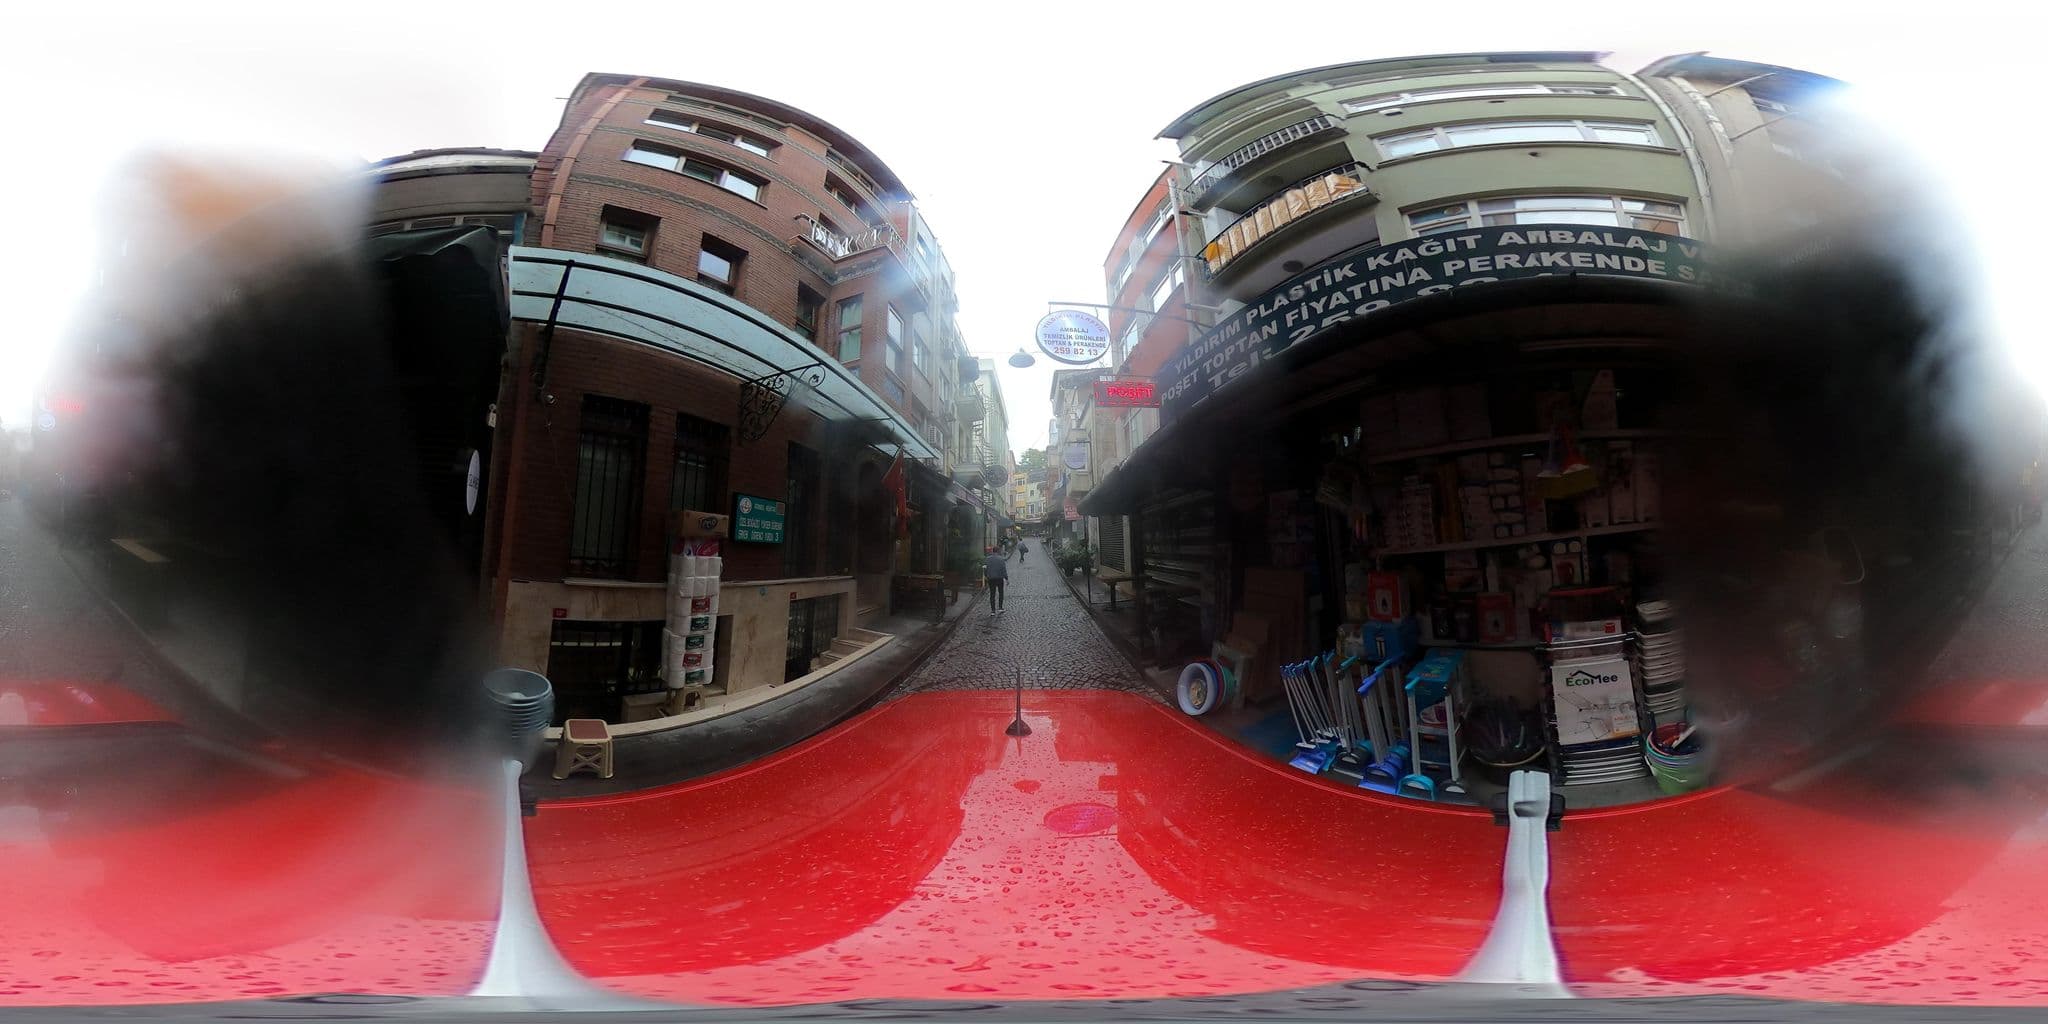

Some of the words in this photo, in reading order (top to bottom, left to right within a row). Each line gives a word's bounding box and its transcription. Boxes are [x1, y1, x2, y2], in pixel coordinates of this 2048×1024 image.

[1161, 368, 1200, 407] POŞET
[1203, 319, 1278, 373] TOPTAN
[1285, 266, 1433, 328] FİYATINA
[1174, 319, 1241, 374] YILDIRIM
[1246, 269, 1357, 326] PLASTİK
[1366, 234, 1482, 271] KAĞIT
